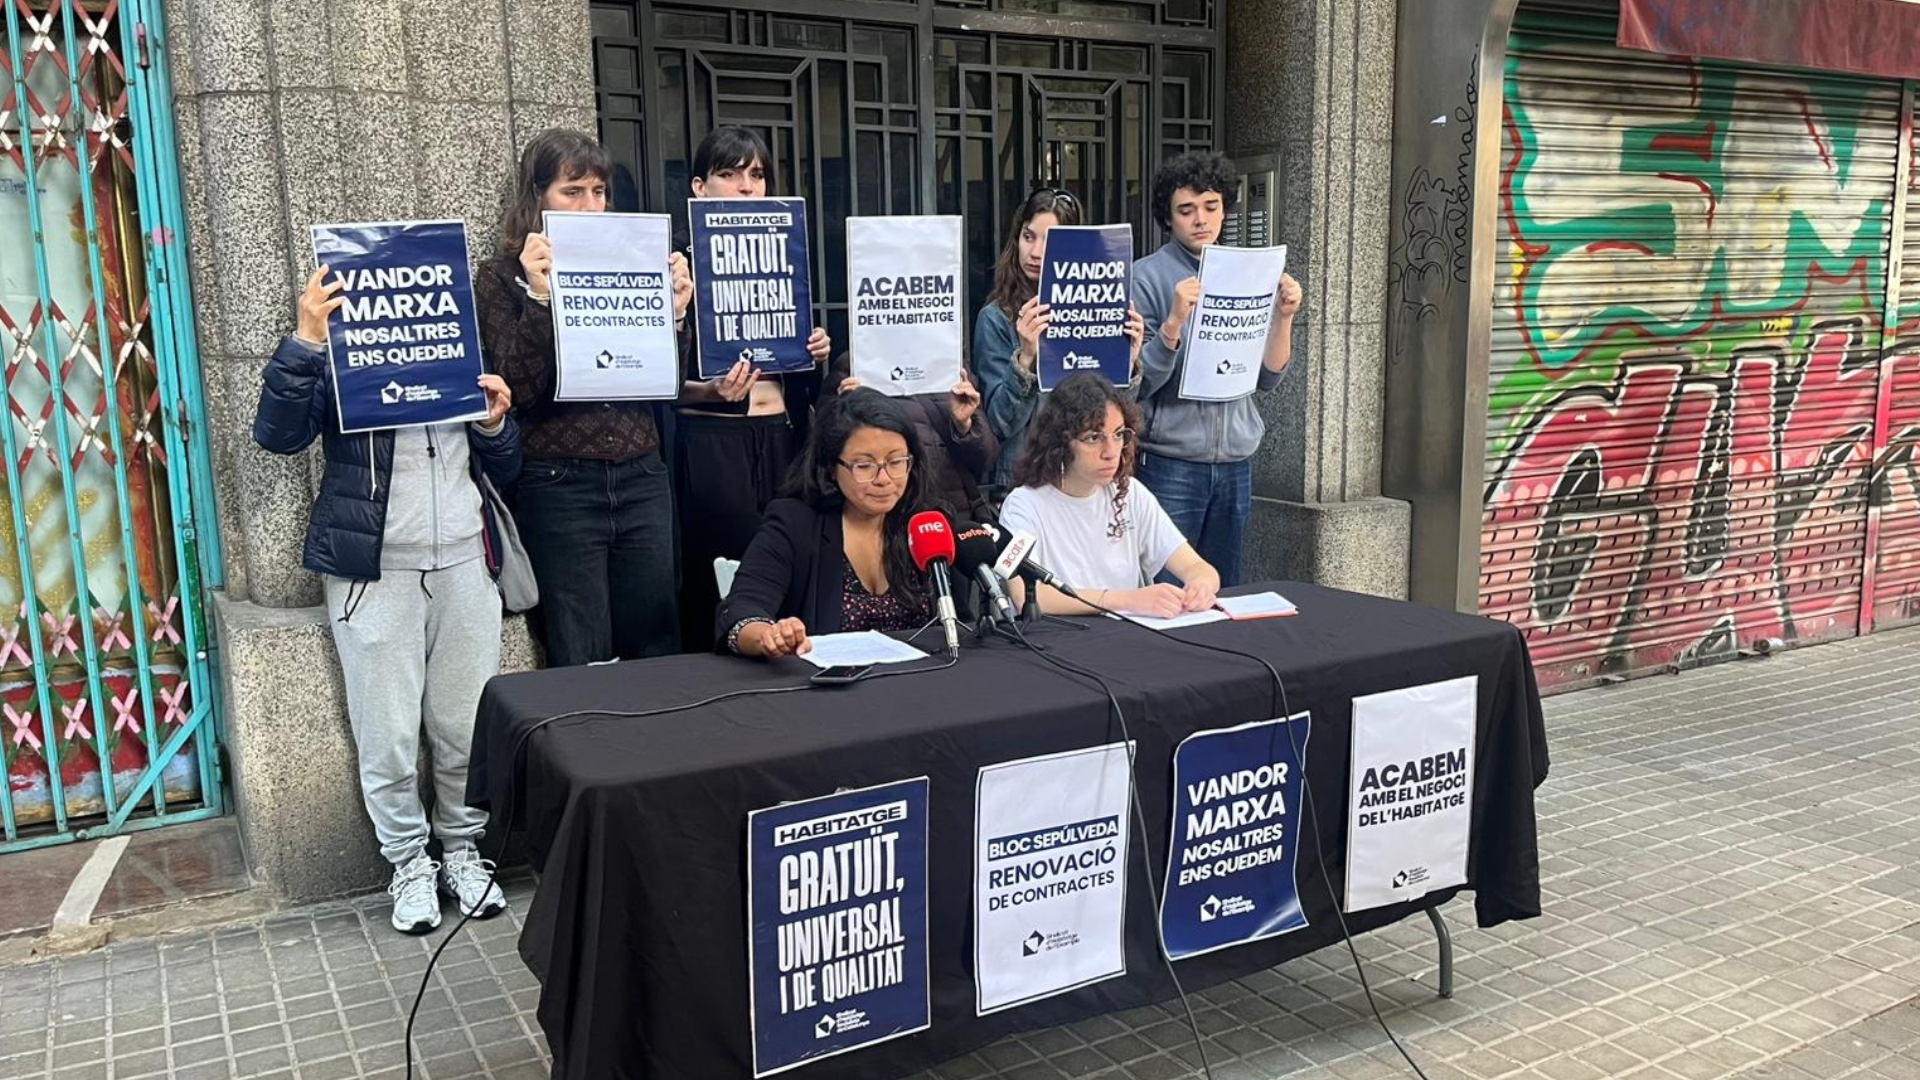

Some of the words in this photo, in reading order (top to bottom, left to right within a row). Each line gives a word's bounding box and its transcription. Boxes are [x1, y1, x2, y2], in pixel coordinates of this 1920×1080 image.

[709, 214, 789, 226] HABITATGE
[710, 227, 794, 275] GRATUÏT,
[335, 264, 453, 291] VANDOR
[559, 276, 593, 288] BLOC
[595, 273, 663, 288] SEPÚLVEDA
[1053, 261, 1125, 280] VANDOR
[712, 278, 796, 314] UNIVERSAL
[857, 275, 954, 297] ACABEM
[1052, 283, 1125, 304] MARXA
[341, 291, 460, 322] MARXA
[563, 293, 664, 311] RENOVACIÓ
[858, 298, 891, 310] AMB
[892, 298, 906, 310] EL
[908, 296, 954, 308] NEGOCI
[1050, 308, 1124, 323] NOSALTRES
[1204, 298, 1232, 307] BLOC
[345, 322, 461, 346] NOSALTRES
[565, 316, 581, 327] DE
[583, 315, 665, 327] CONTRACTES
[716, 315, 721, 342] I
[725, 315, 740, 342] DE
[742, 312, 797, 341] QUALITAT
[858, 315, 874, 326] DE
[1047, 326, 1070, 338] ENS
[1072, 325, 1123, 338] QUEDEM
[1199, 330, 1213, 340] DE
[348, 349, 384, 367] ENS
[386, 343, 465, 366] QUEDEM
[918, 521, 944, 534] rne
[1359, 748, 1466, 792] ACABEM
[1188, 762, 1288, 806] VANDOR
[1359, 790, 1398, 809] AMB
[1400, 786, 1415, 801] EL
[1416, 773, 1466, 798] NEGOCI
[780, 806, 902, 842] HABITATGE
[1186, 790, 1286, 841] MARXA
[1359, 813, 1377, 827] DE
[988, 838, 1031, 860] BLOC
[1032, 820, 1118, 850] SEPÚLVEDA
[1182, 824, 1283, 865] NOSALTRES
[780, 826, 904, 914] GRATUÏT,
[989, 846, 1116, 889] RENOVACIÓ
[1179, 866, 1212, 886] ENS
[1216, 845, 1282, 877] QUEDEM
[989, 895, 1009, 911] DE
[1012, 871, 1114, 906] CONTRACTES
[778, 897, 904, 971] UNIVERSAL
[780, 976, 788, 1014] I
[793, 970, 816, 1010] DE
[823, 946, 904, 1003] QUALITAT
